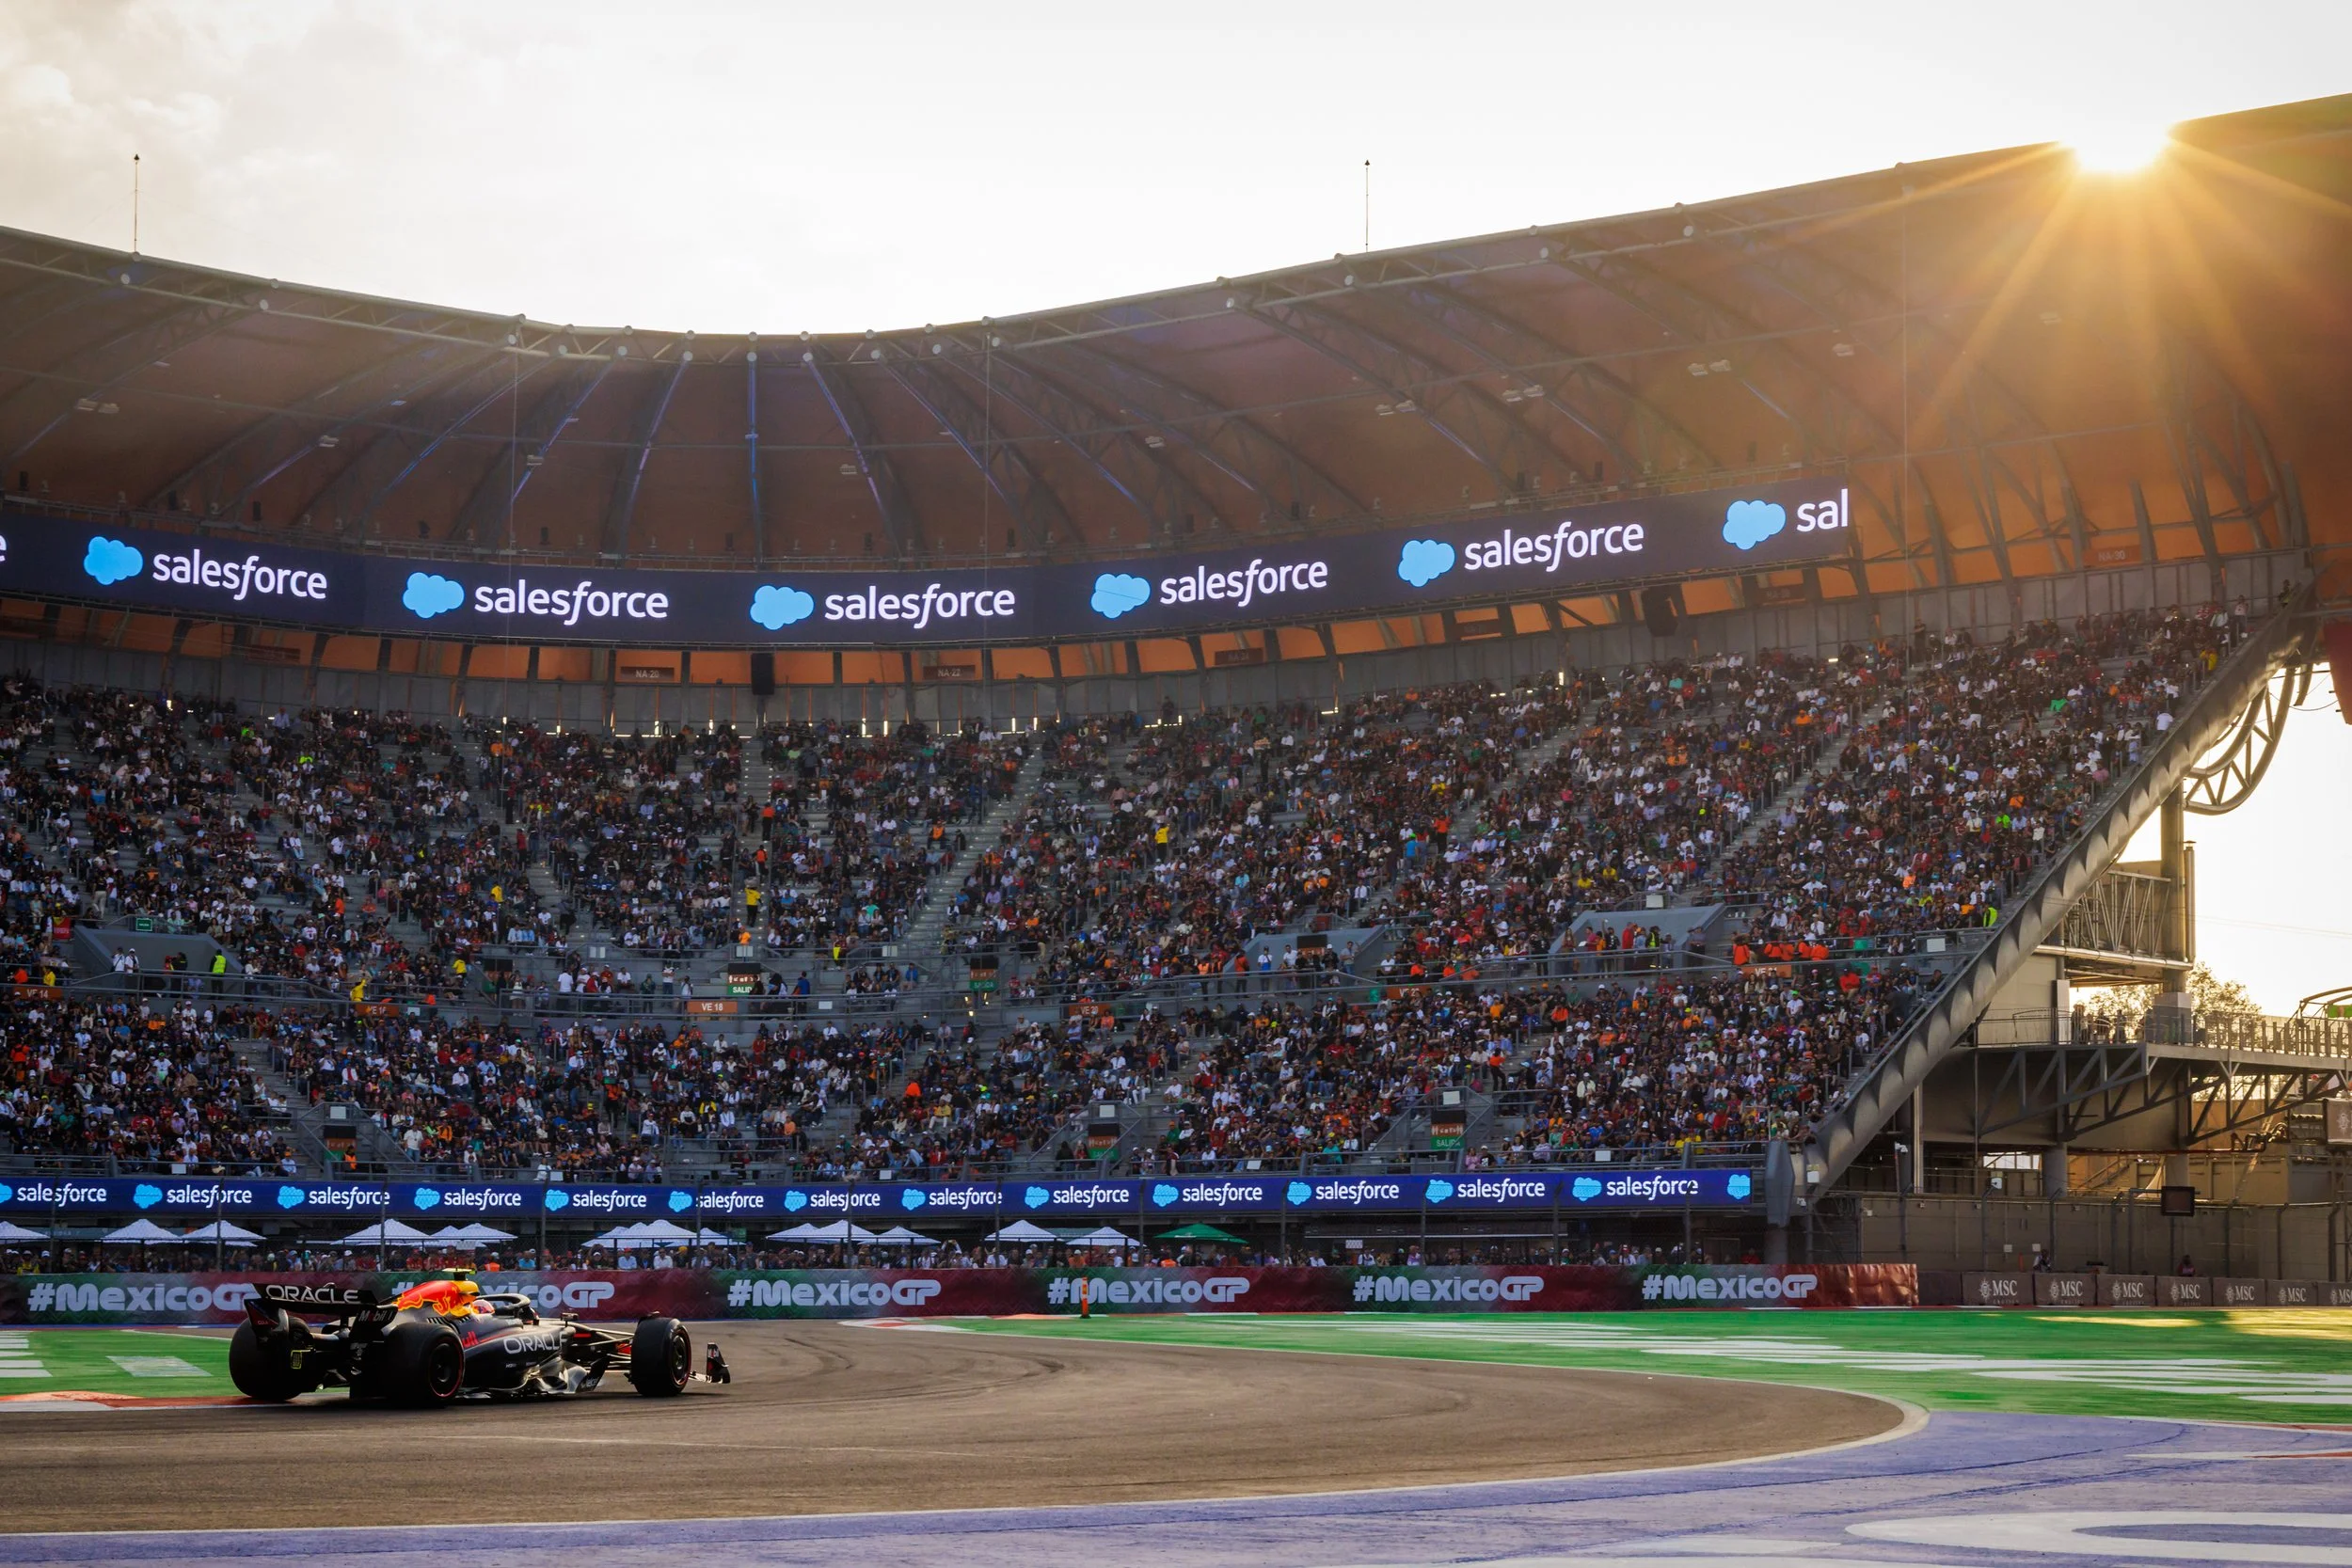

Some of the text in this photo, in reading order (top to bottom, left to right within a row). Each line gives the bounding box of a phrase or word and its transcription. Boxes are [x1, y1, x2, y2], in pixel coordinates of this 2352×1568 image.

[1464, 521, 1645, 572] salesforce
[152, 549, 327, 600] salesforce
[1159, 559, 1328, 607] salesforce
[474, 578, 669, 626] salesforce
[824, 583, 1016, 629] salesforce
[40, 990, 49, 998] 14
[702, 1003, 723, 1011] VE 18
[17, 1182, 107, 1208] salesforce
[167, 1184, 252, 1209] salesforce
[308, 1186, 390, 1210] salesforce
[443, 1188, 522, 1212] salesforce
[572, 1189, 647, 1212] salesforce
[810, 1189, 881, 1212] salesforce
[1053, 1184, 1130, 1209] salesforce
[1182, 1182, 1263, 1207] salesforce
[1315, 1180, 1400, 1205] salesforce
[1457, 1178, 1546, 1203] salesforce
[1606, 1175, 1699, 1201] salesforce
[265, 1285, 361, 1305] ORACLE
[727, 1279, 942, 1307] #MexicoGP
[1047, 1277, 1250, 1305] #MexicoGP
[1352, 1275, 1545, 1302] #MexicoGP
[1642, 1274, 1818, 1301] #MexicoGP
[1992, 1280, 2018, 1296] MSC
[2060, 1281, 2083, 1297] MSC
[2122, 1282, 2144, 1298] MSC
[2180, 1284, 2201, 1299] MSC
[2235, 1285, 2255, 1301] MSC
[2287, 1287, 2307, 1302] MSC
